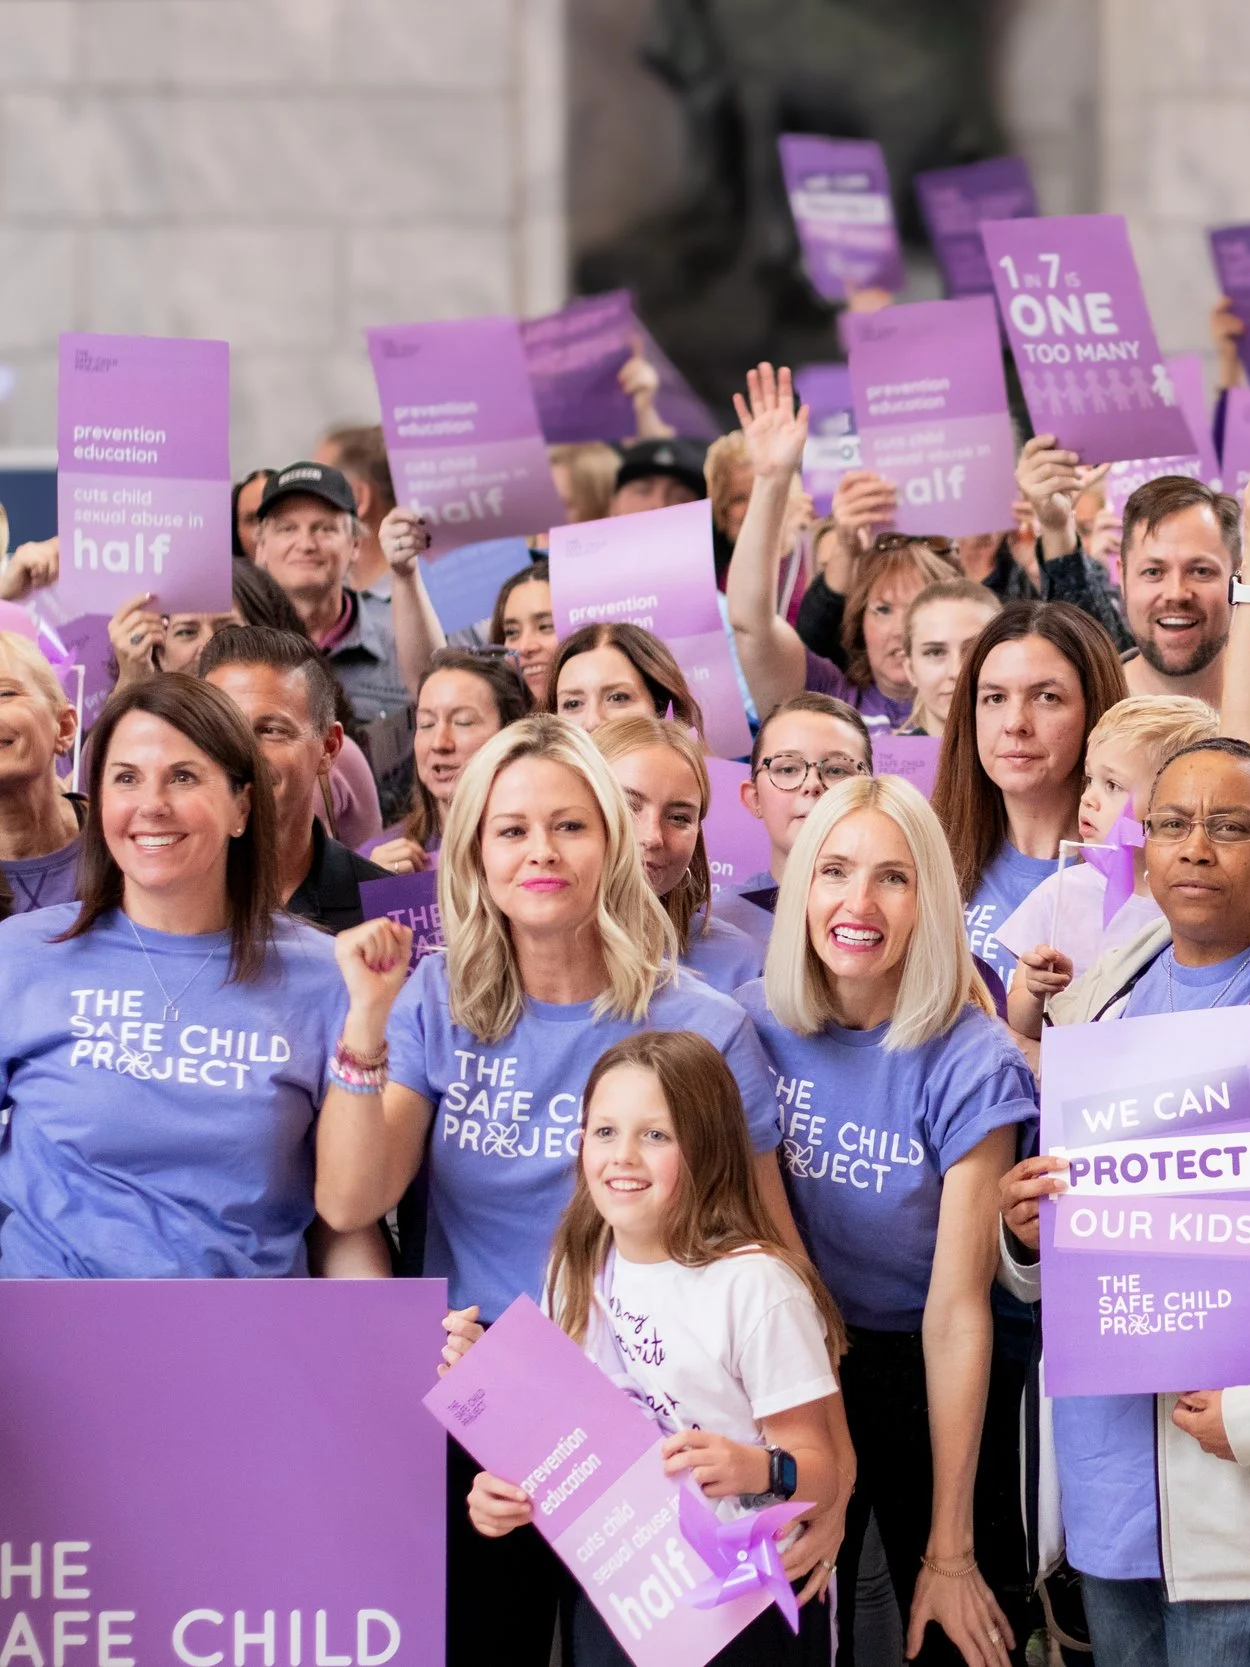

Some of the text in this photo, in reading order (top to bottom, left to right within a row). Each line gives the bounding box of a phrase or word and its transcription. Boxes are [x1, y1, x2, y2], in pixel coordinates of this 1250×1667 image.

[998, 255, 1020, 289] 1
[1038, 253, 1060, 289] 7
[1009, 292, 1119, 337] ONE
[1022, 341, 1140, 365] TOO MANY
[74, 424, 166, 444] prevention
[74, 443, 158, 464] education
[74, 487, 152, 506] cuts child
[409, 486, 504, 526] half
[74, 507, 204, 529] sexual abuse in
[73, 527, 172, 576] half
[568, 593, 659, 626] prevention
[71, 988, 145, 1018] THE
[69, 1015, 291, 1064] SAFE CHILD
[454, 1049, 518, 1088] THE
[445, 1081, 534, 1122] SAFE
[1081, 1081, 1231, 1133] WE CAN
[838, 1121, 925, 1167] CHILD
[1069, 1146, 1248, 1187] PROTECT
[1070, 1208, 1153, 1240] OUR
[1097, 1274, 1141, 1295] THE
[1098, 1289, 1232, 1315] SAFE CHILD
[520, 1427, 589, 1498] prevention
[540, 1453, 602, 1516] education
[576, 1500, 636, 1563] cuts child
[593, 1538, 636, 1586] sexual
[631, 1507, 673, 1550] abuse
[608, 1536, 697, 1641] half
[172, 1608, 401, 1667] CHILD
